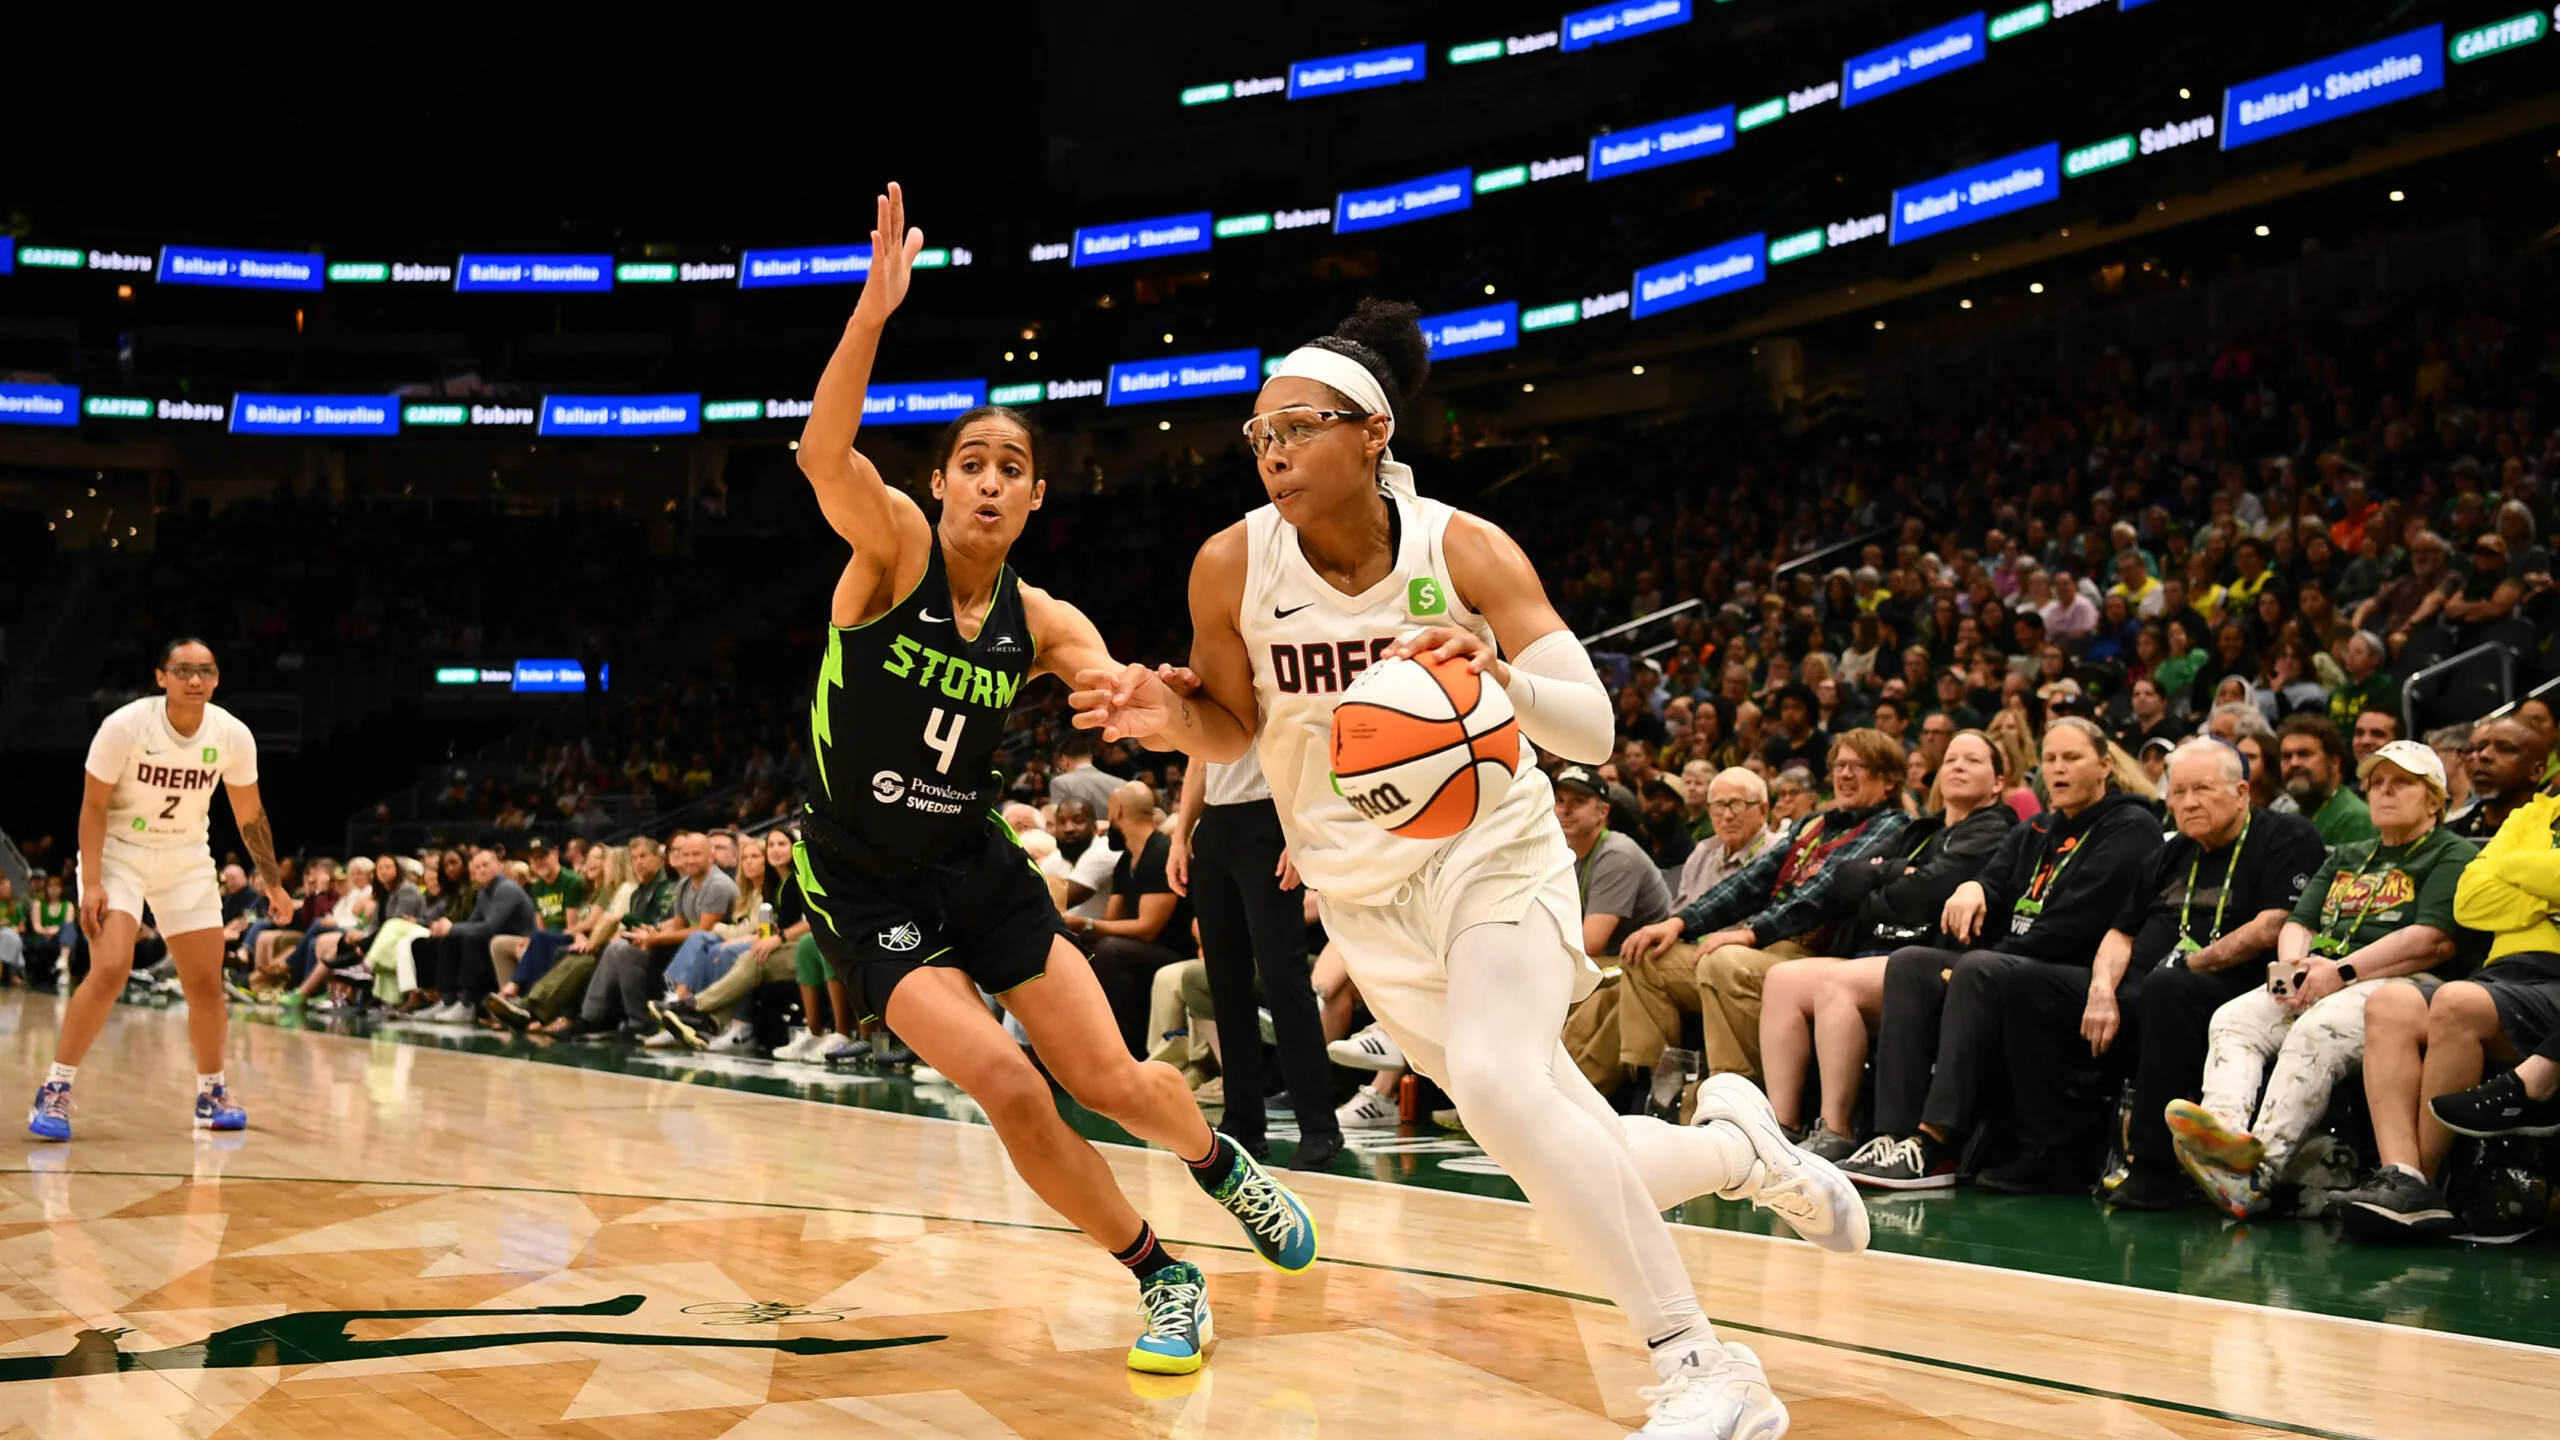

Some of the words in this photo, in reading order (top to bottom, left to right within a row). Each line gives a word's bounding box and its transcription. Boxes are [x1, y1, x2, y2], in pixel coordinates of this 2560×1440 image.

[2456, 15, 2538, 59] CARTER
[2239, 83, 2309, 126] Ballard
[2324, 54, 2423, 101] Shoreline
[2139, 114, 2215, 155] Subaru
[883, 634, 1020, 709] STORM
[1270, 636, 1397, 694] DRE
[923, 707, 966, 775] 4
[137, 763, 217, 790] DREAM
[159, 796, 181, 819] 2
[906, 796, 962, 814] SWEDISH
